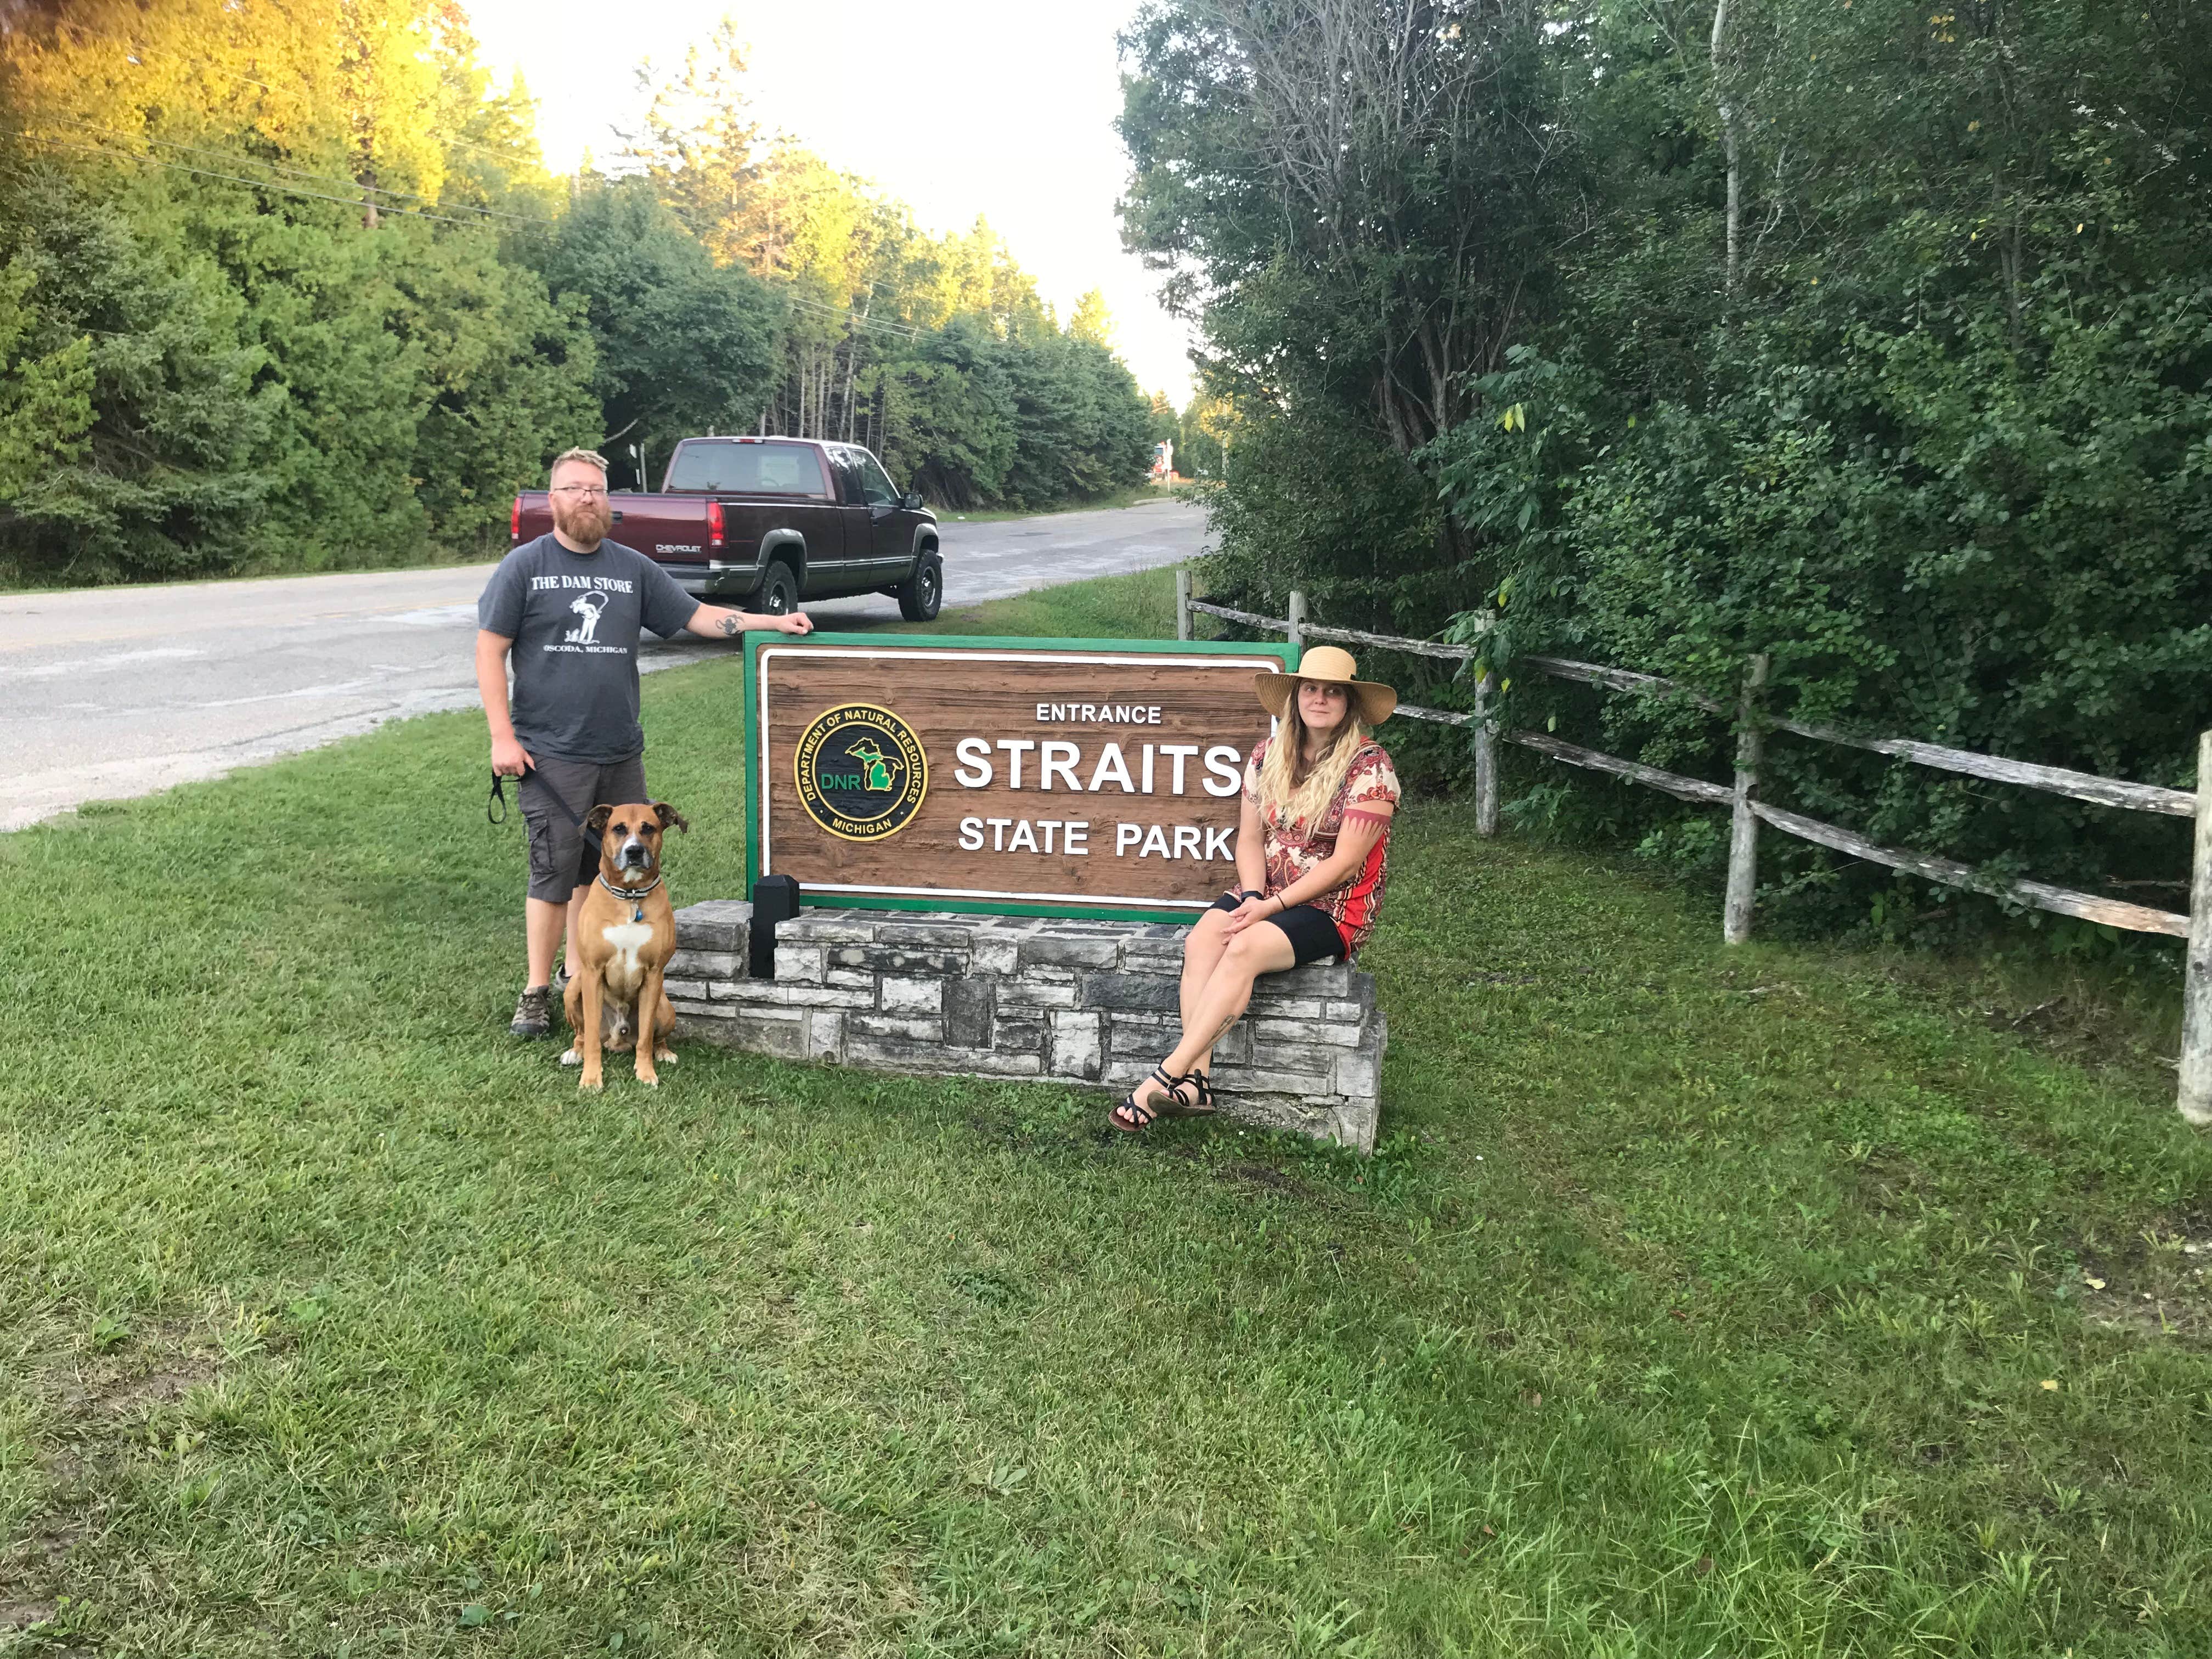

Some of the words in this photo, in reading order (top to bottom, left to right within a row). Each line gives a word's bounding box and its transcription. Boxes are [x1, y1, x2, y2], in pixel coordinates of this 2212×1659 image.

[531, 576, 559, 590] THE
[561, 575, 592, 589] DAM
[594, 577, 633, 593] STORE
[1036, 703, 1161, 724] ENTRANCE
[801, 723, 826, 801] DEPARTMENT
[827, 713, 841, 727] OF
[844, 710, 896, 733] NATURAL
[897, 730, 922, 804] RESOURCES
[953, 737, 1242, 797] STRAITS
[821, 774, 861, 790] DNR
[832, 818, 891, 834] MICHIGAN
[958, 817, 1088, 855] STATE
[1116, 823, 1234, 861] PARK
